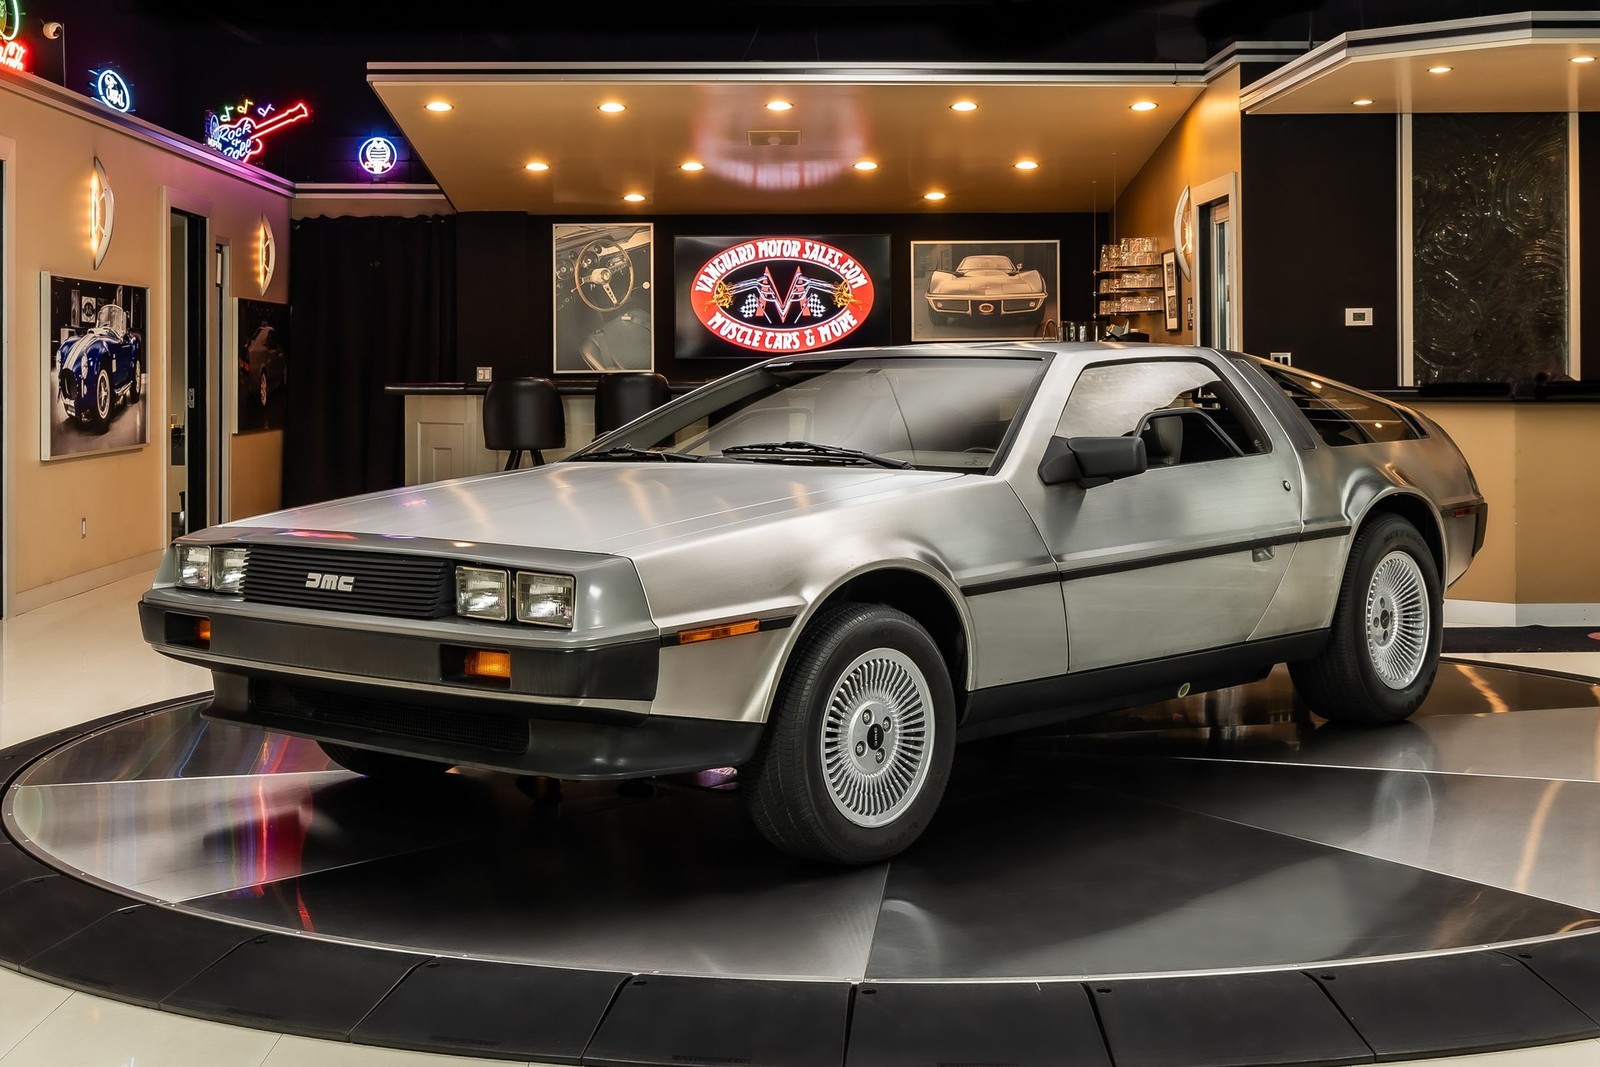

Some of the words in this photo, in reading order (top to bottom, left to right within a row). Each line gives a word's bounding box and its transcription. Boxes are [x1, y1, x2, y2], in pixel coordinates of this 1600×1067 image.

[216, 118, 252, 143] Rock
[695, 243, 756, 293] VANGUARD
[756, 239, 802, 259] MOTOR
[802, 241, 868, 289] SALES.COM
[706, 311, 764, 347] MUSCLE
[764, 331, 801, 350] CARS
[803, 328, 816, 347] &
[817, 309, 858, 344] MORE
[305, 572, 355, 592] DMC
